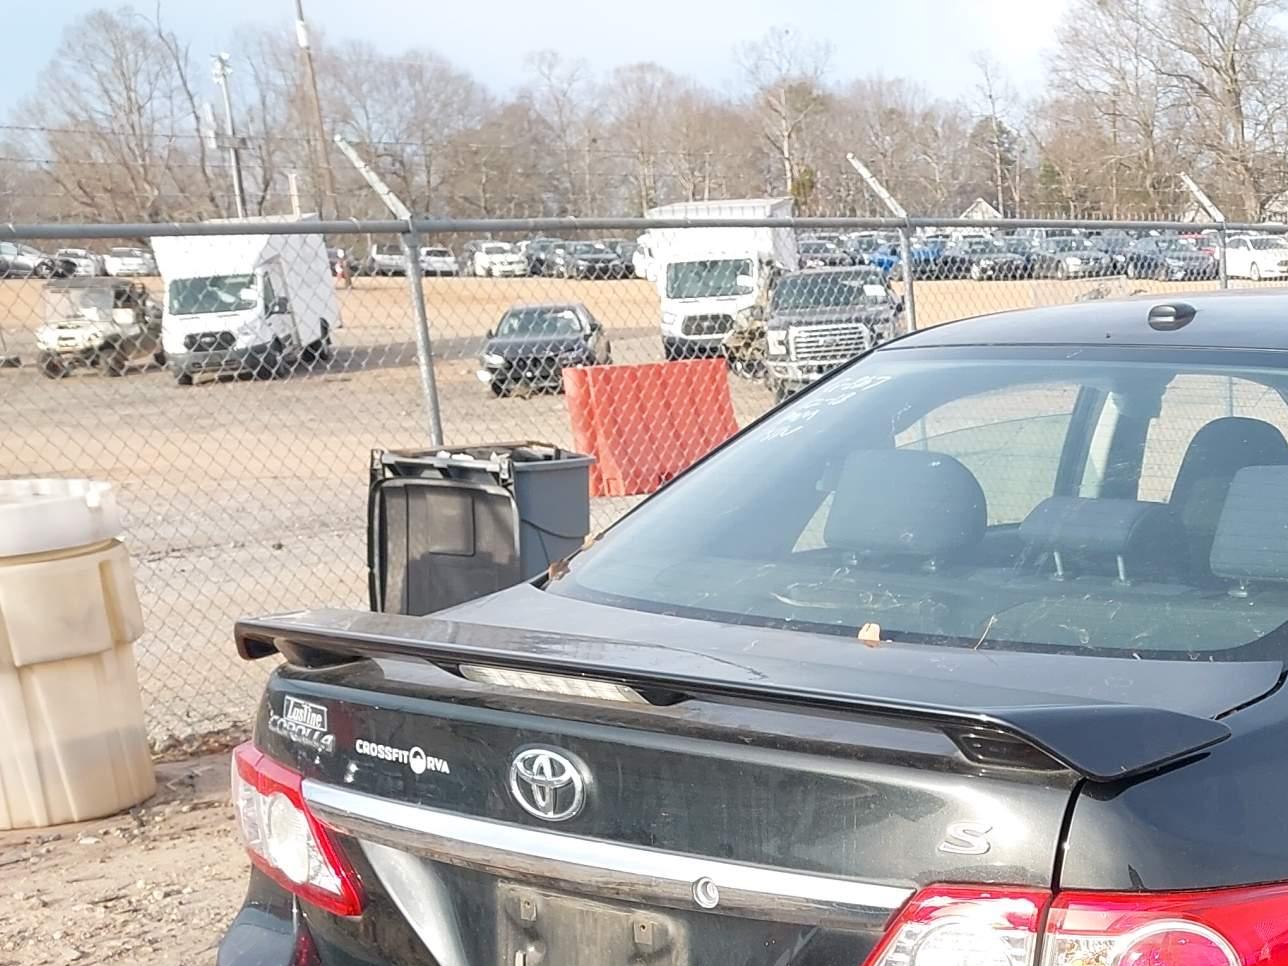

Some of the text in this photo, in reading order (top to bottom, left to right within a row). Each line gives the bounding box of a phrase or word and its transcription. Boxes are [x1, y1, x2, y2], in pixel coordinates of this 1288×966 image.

[267, 715, 336, 753] COROLLA
[355, 739, 450, 774] CROSSFIT RVA
[937, 821, 994, 856] S
